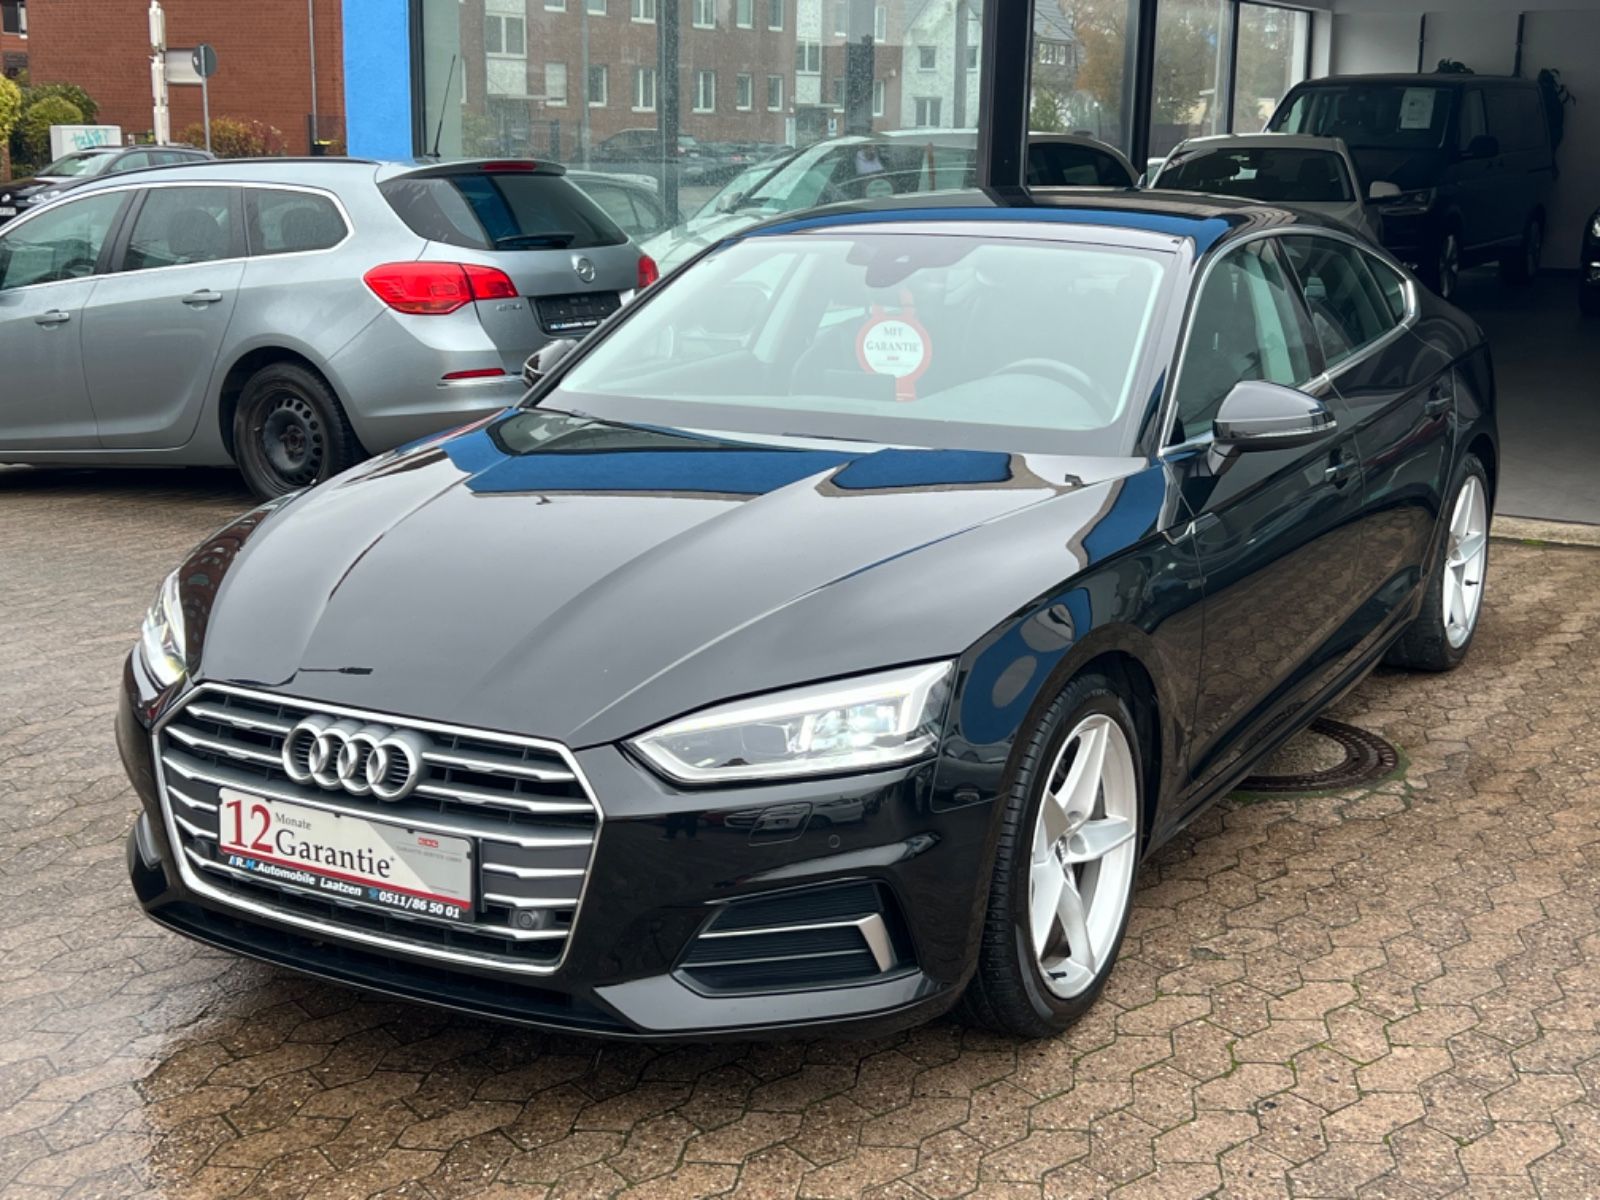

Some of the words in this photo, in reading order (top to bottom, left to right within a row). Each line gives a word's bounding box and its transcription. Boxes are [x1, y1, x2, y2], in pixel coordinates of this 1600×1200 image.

[883, 327, 904, 337] MIT
[866, 340, 920, 353] GARANTIE
[226, 799, 273, 854] 12
[275, 812, 312, 830] Monate
[320, 877, 362, 896] Laatzen
[379, 891, 428, 911] 0511/86
[428, 903, 443, 915] 50
[445, 907, 460, 919] 01
